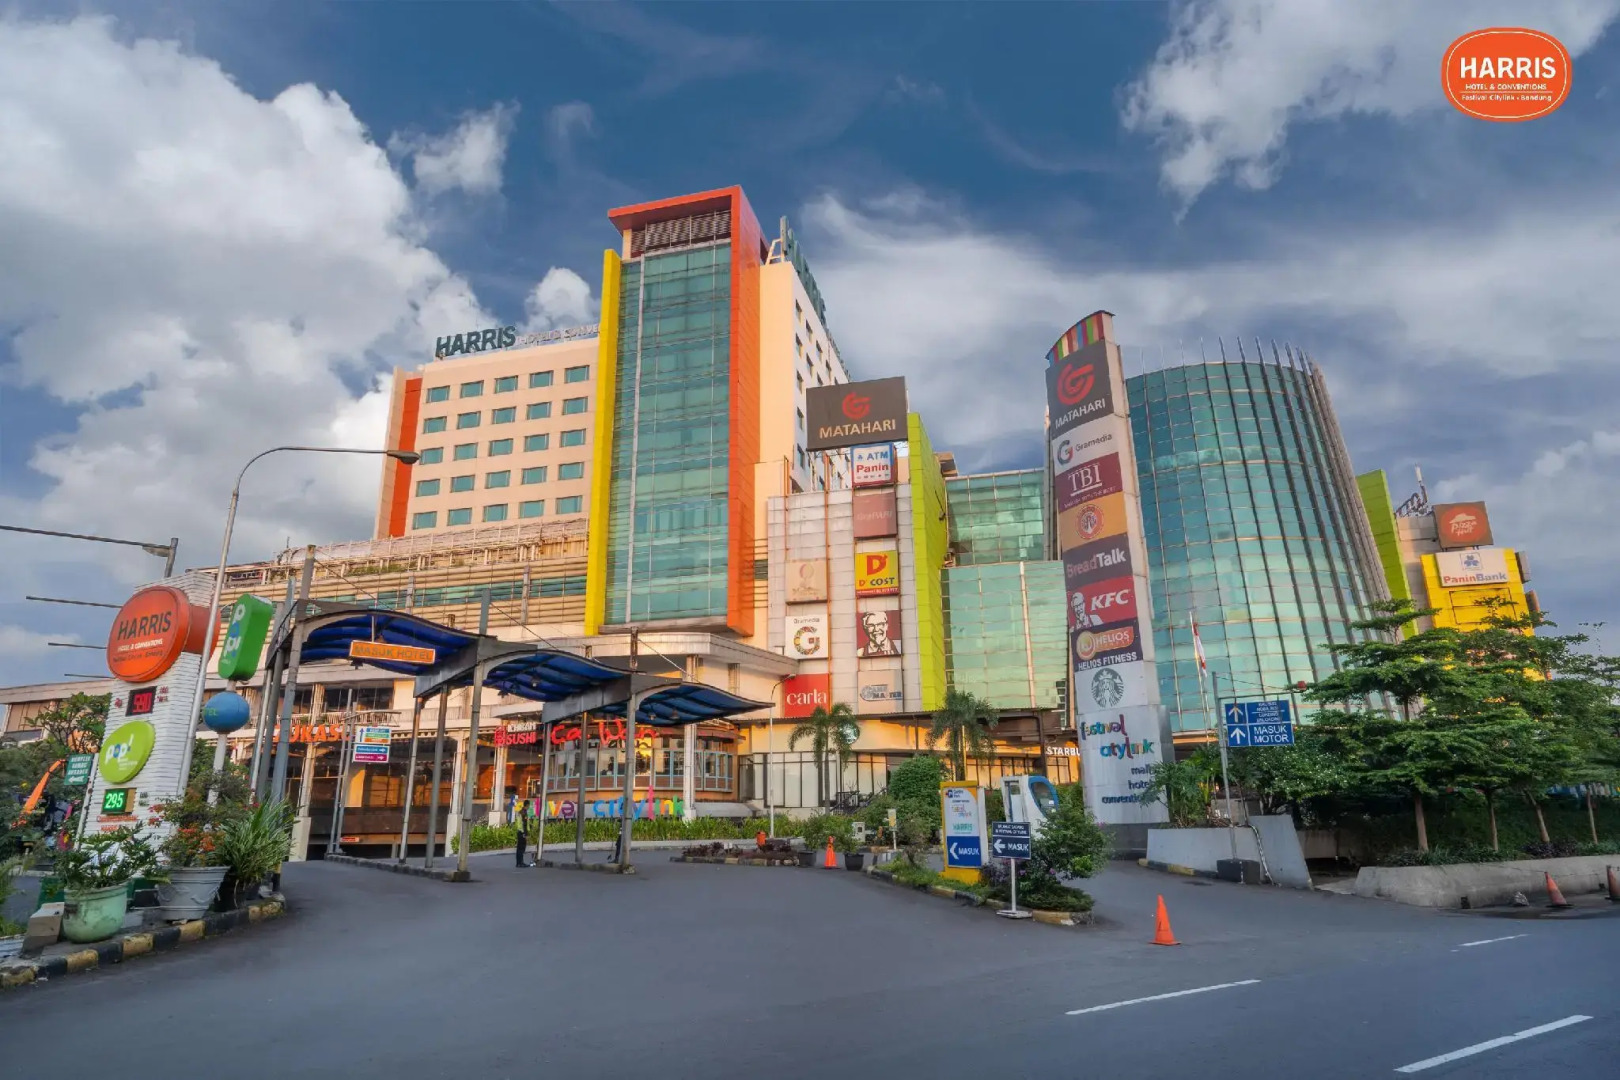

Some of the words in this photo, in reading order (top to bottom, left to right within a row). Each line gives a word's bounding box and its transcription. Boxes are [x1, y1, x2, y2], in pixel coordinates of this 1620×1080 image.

[435, 325, 516, 358] HARRIS
[1055, 398, 1106, 429] MATAHARI
[819, 418, 896, 439] MATAHARI
[1075, 433, 1113, 453] Gramedia
[867, 451, 889, 460] ATM
[856, 463, 889, 473] Panin
[1067, 464, 1102, 491] TBI
[1067, 548, 1127, 578] BreadTalk
[870, 577, 895, 586] COST
[1443, 572, 1507, 584] PaninBank
[1091, 589, 1130, 611] KFC
[117, 611, 171, 640] HARRIS
[1096, 630, 1130, 645] HELIOS
[396, 649, 431, 660] HOTEL
[1078, 658, 1102, 670] HELIOS
[1102, 651, 1138, 665] FITNESS
[786, 688, 827, 706] carla
[508, 722, 536, 732] ICHIBAN
[1253, 725, 1287, 735] MASUK
[506, 732, 536, 745] SUSHI
[1254, 735, 1289, 743] MOTOR
[1100, 736, 1155, 760] citylink
[103, 793, 124, 808] 295
[958, 847, 980, 856] MASUK
[1007, 842, 1029, 851] MASUK
